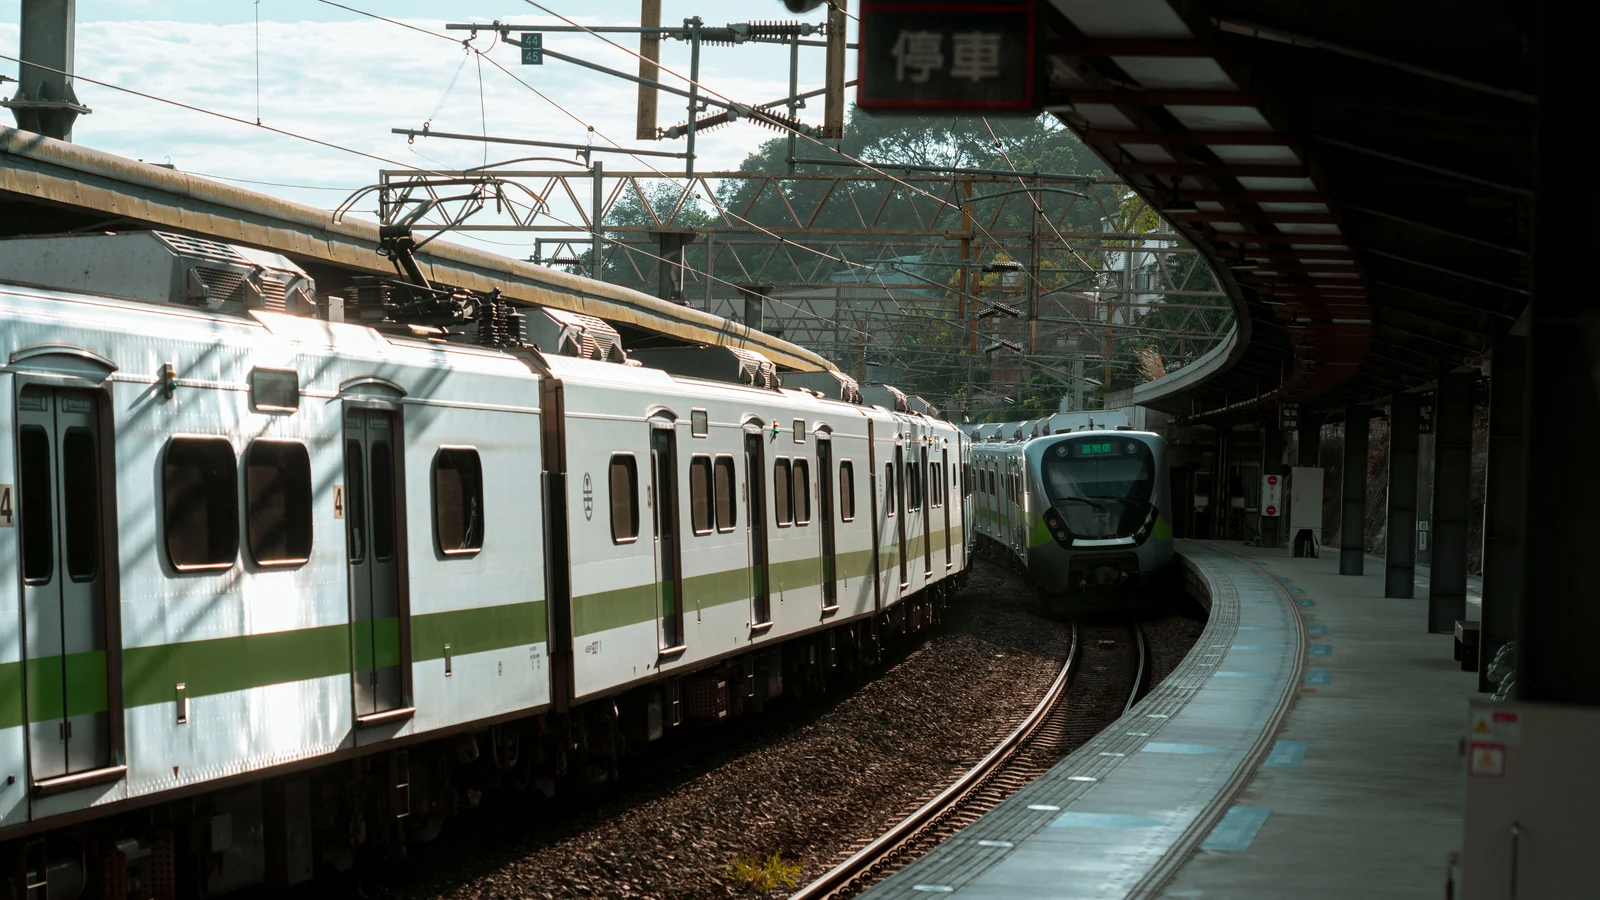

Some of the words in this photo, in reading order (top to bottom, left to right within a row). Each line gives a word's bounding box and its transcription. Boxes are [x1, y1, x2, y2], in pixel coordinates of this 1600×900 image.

[525, 35, 538, 46] 44
[525, 51, 539, 62] 45
[890, 29, 1001, 83] 停車
[1081, 443, 1111, 454] 區間車
[1, 487, 12, 523] 4
[335, 487, 343, 516] 4
